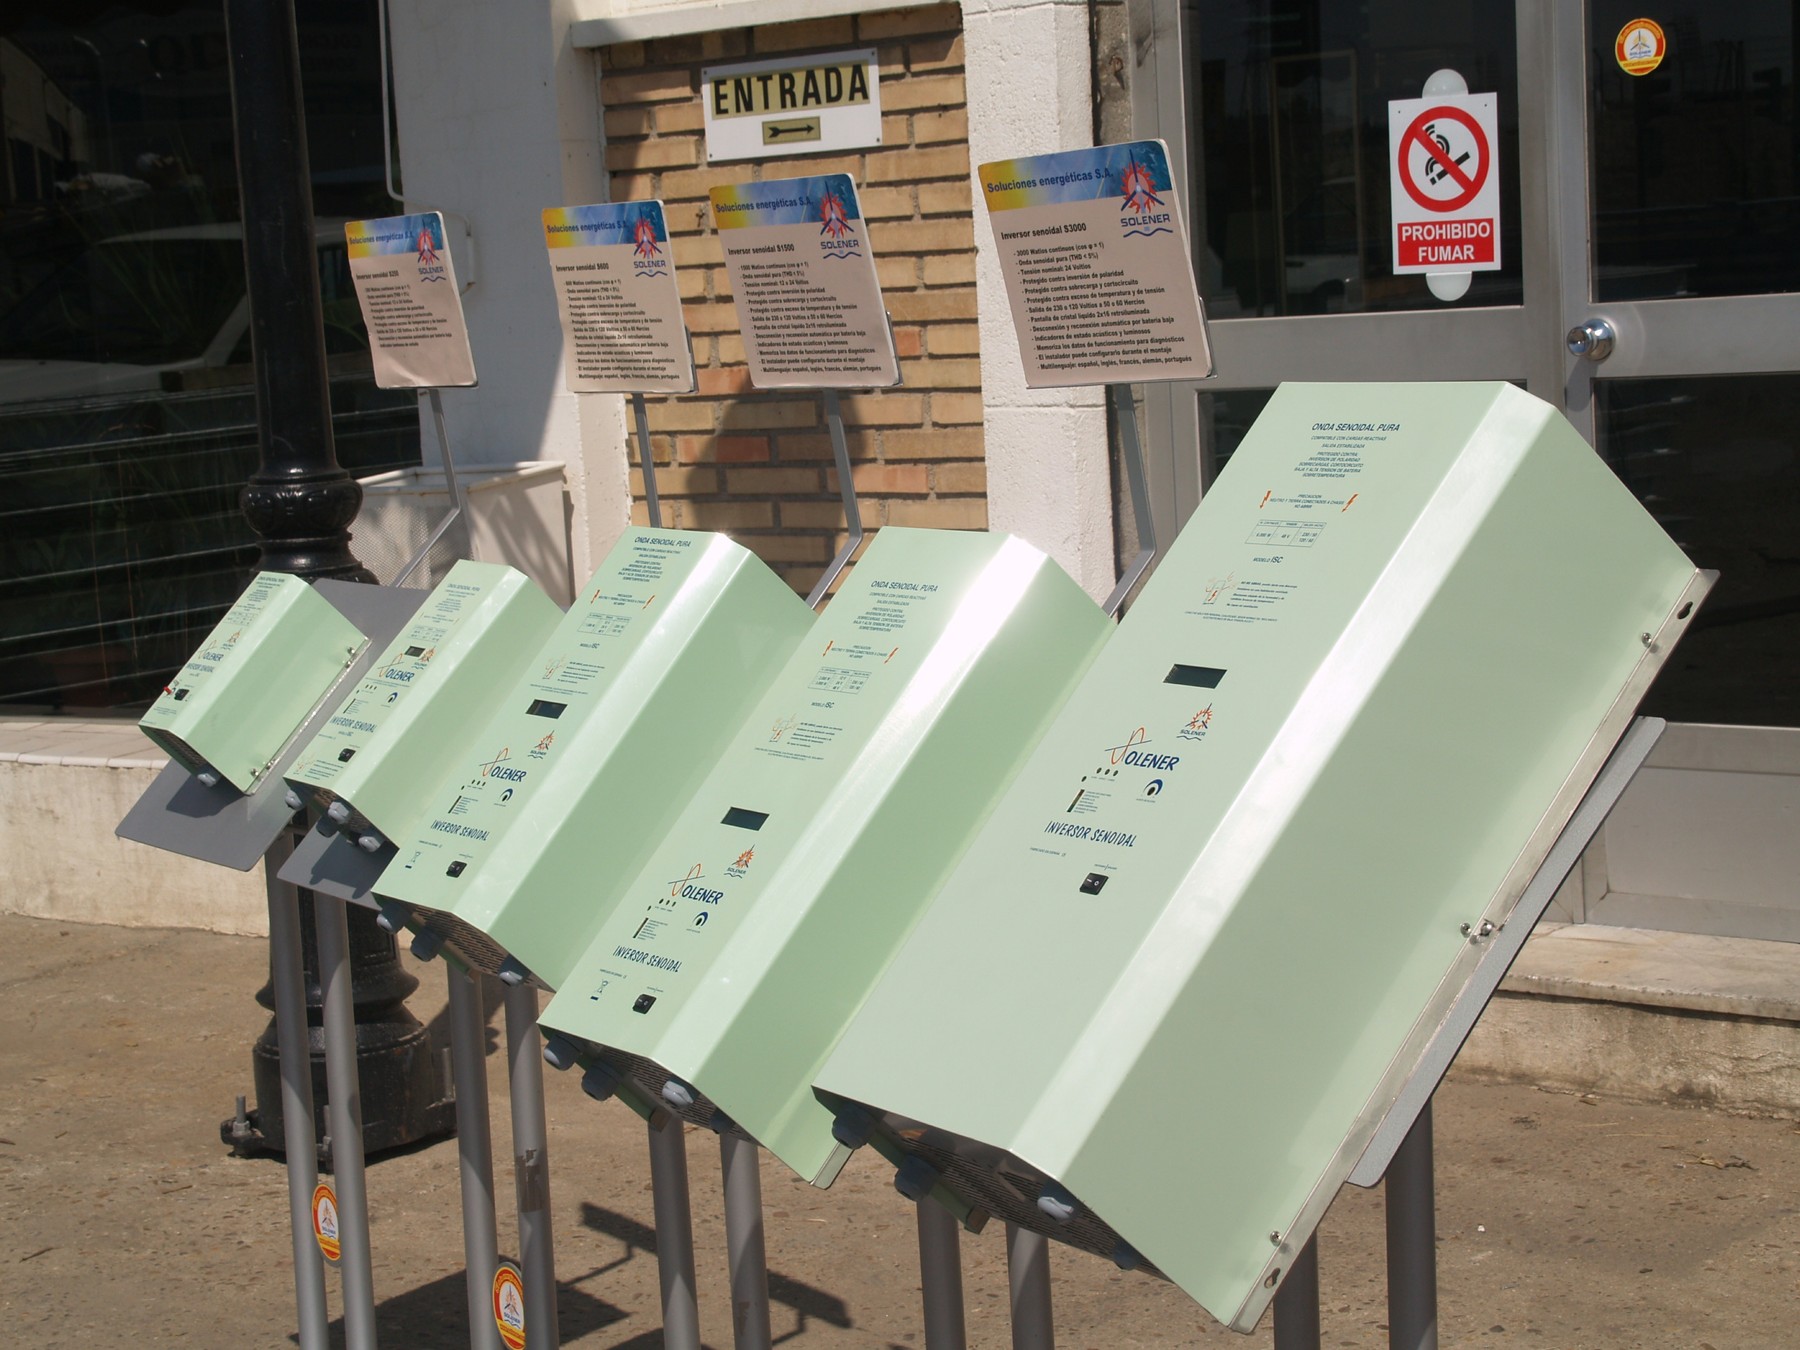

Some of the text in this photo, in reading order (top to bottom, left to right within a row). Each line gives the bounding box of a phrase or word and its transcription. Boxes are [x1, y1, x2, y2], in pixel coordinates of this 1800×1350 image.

[714, 63, 869, 115] ENTRADA
[987, 167, 1114, 192] Soluciones energéticas S.A.
[716, 202, 754, 213] Soluciones
[756, 198, 797, 211] energéticas
[1120, 213, 1171, 227] SOLENER
[547, 224, 579, 233] Soluciones
[580, 221, 616, 234] energéticas
[1000, 222, 1086, 239] Inversor senoidal S3000
[1401, 222, 1490, 242] PROHIBIDO
[751, 245, 776, 253] senoidal
[776, 243, 794, 252] S1500
[820, 239, 859, 249] SOLENER
[1418, 244, 1475, 262] FUMAR
[418, 266, 444, 275] SOLENER
[634, 260, 666, 269] SOLENER
[1311, 423, 1334, 431] ONDA
[1335, 423, 1375, 431] SENOIDAL
[634, 536, 650, 544] ONDA
[889, 582, 919, 591] SENOIDAL
[919, 584, 939, 592] PURA
[329, 715, 377, 733] INVERSOR SENOIDAL
[1179, 729, 1206, 737] SOLENER
[431, 819, 490, 841] INVERSOR SENOIDAL
[1044, 821, 1137, 847] INVERSOR SENOIDAL
[613, 945, 683, 973] INVERSOR SENOIDAL
